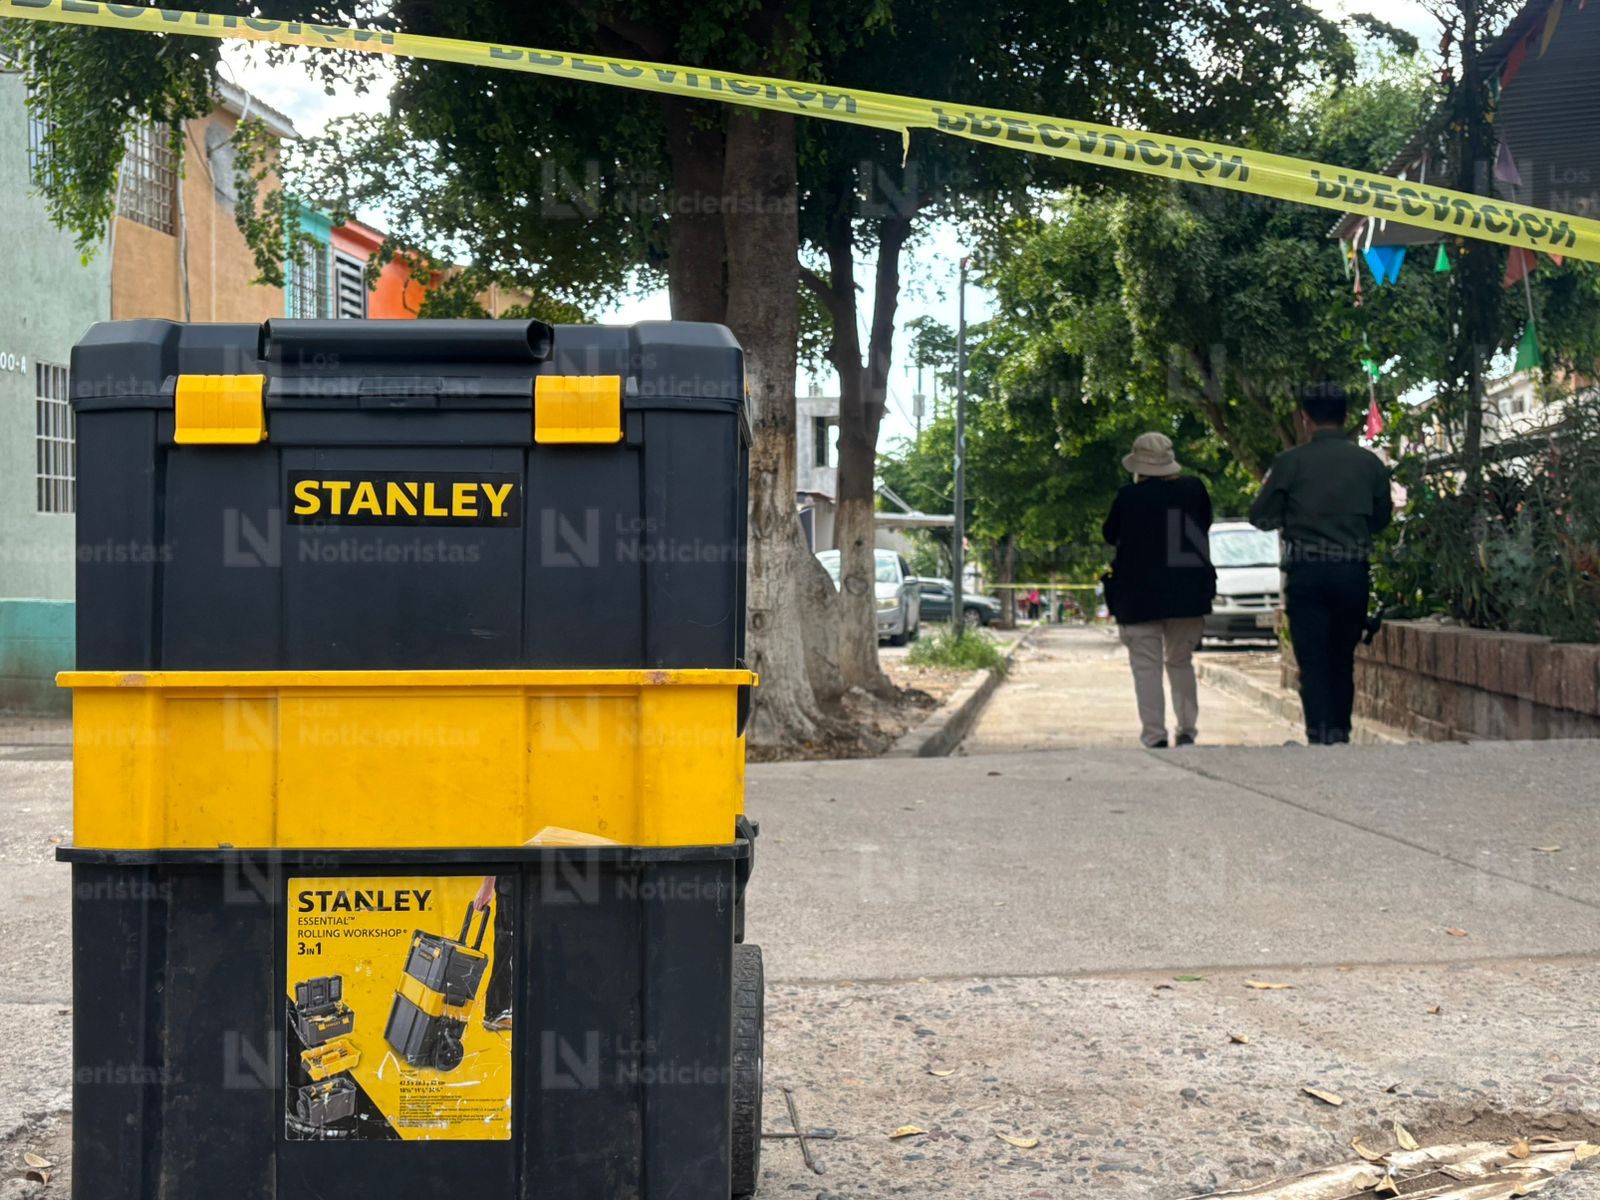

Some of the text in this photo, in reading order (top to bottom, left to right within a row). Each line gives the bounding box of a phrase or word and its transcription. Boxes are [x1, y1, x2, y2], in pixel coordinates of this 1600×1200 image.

[294, 480, 514, 517] STANLEY
[298, 889, 431, 912] STANLEY
[298, 929, 340, 938] ROLLING
